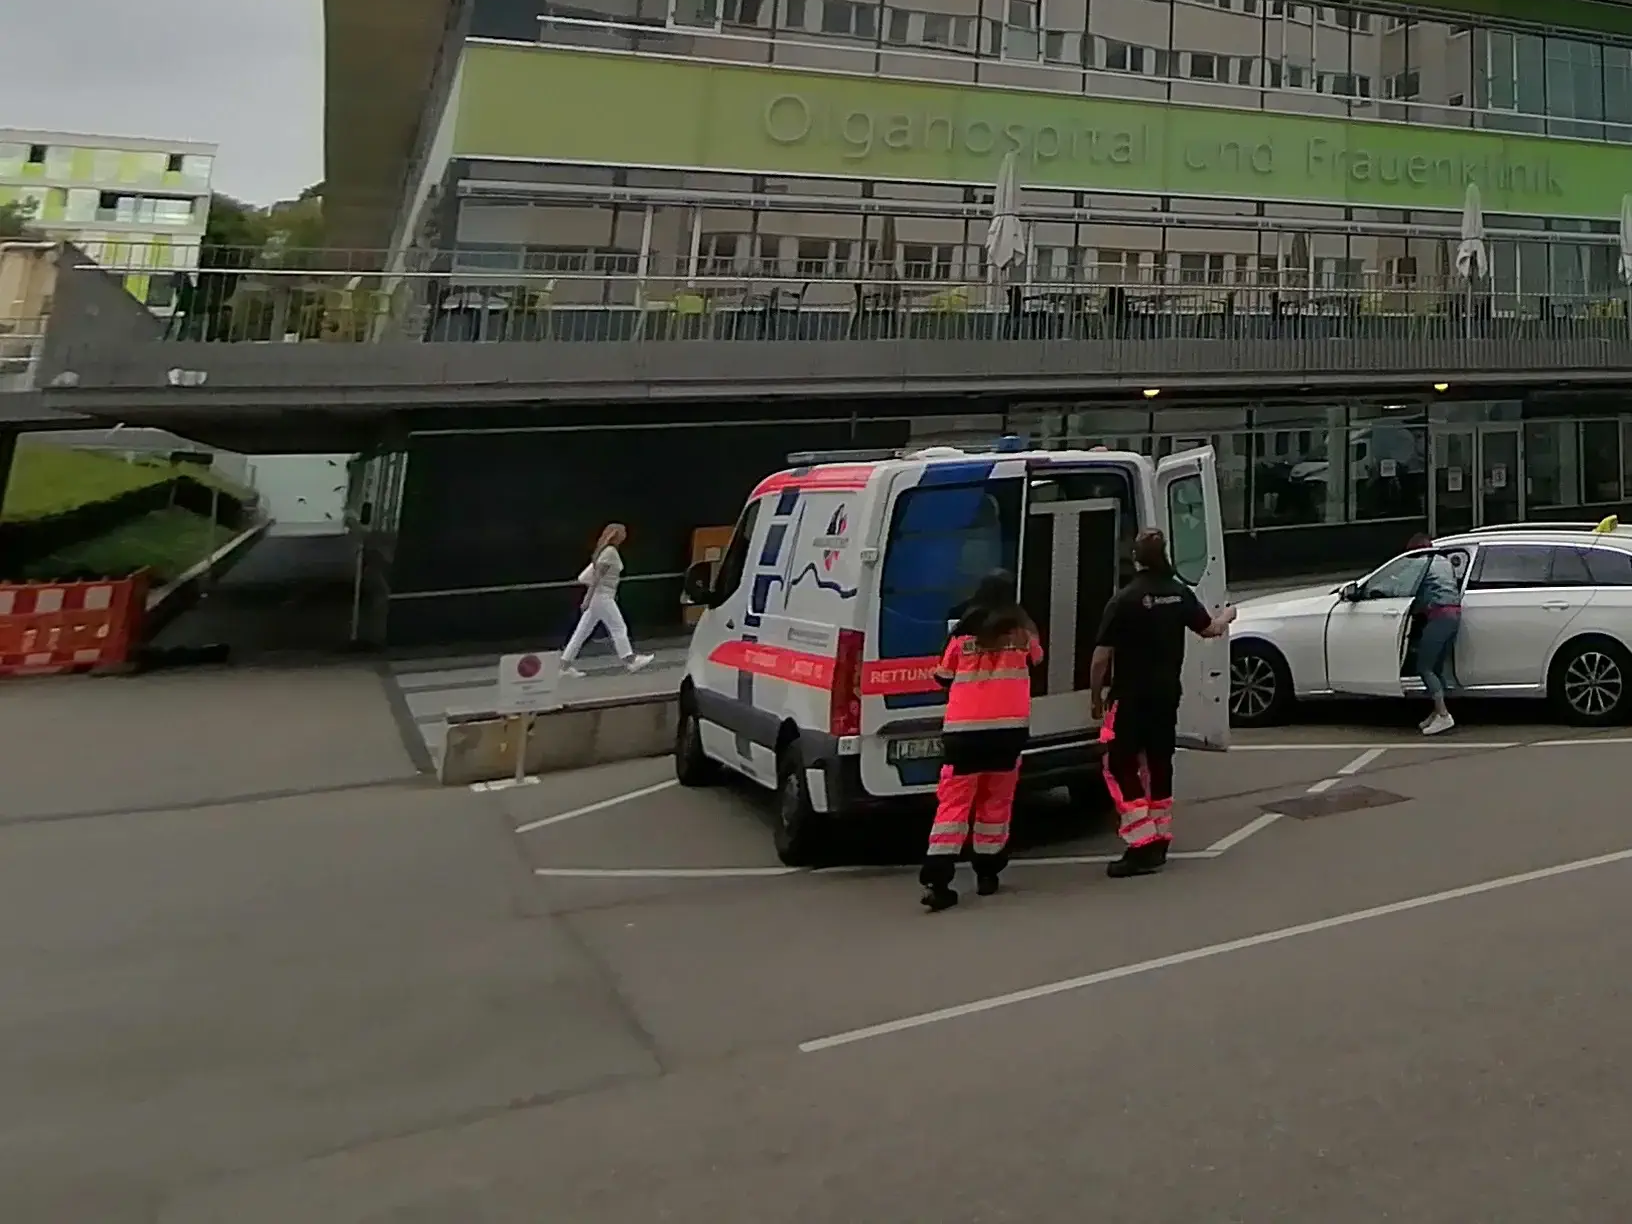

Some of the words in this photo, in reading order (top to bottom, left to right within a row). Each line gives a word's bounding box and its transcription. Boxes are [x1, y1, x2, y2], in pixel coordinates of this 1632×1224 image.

[763, 93, 1150, 165] Olgahospital
[1182, 134, 1276, 175] und
[1306, 137, 1564, 197] Frauenklinik
